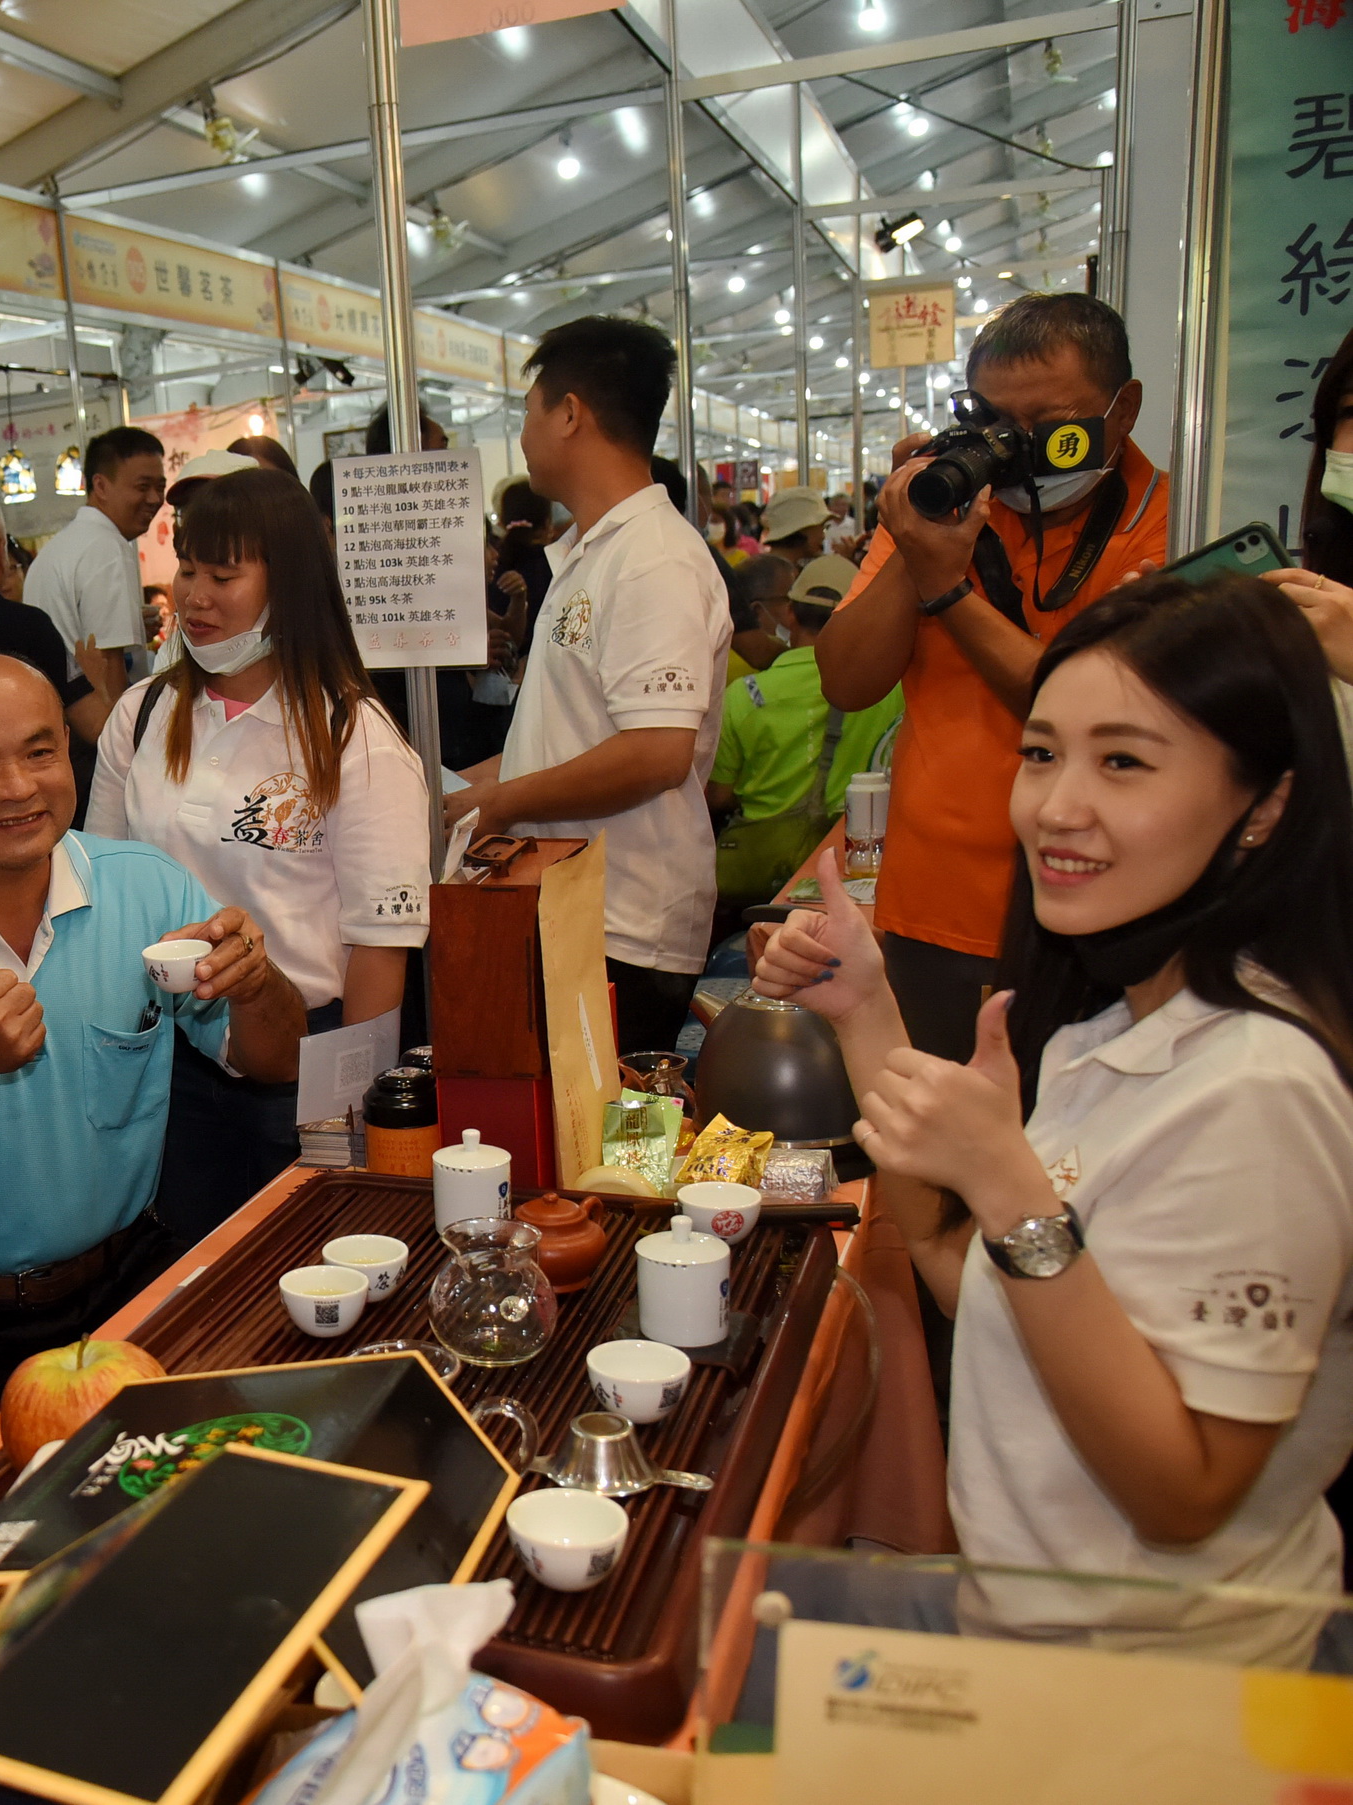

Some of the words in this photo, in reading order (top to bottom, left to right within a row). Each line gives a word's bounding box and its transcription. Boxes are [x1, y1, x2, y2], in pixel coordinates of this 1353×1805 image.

[949, 429, 968, 437] Nikon
[1055, 432, 1081, 460] 勇
[343, 506, 355, 516] 10
[357, 502, 393, 516] 點半泡
[395, 501, 419, 513] 103k
[422, 496, 471, 512] 英雄冬茶
[343, 524, 355, 535] 11
[344, 542, 356, 552] 12
[358, 536, 442, 552] 點泡高海拔秋茶
[344, 561, 351, 571] 2
[353, 558, 377, 571] 點泡
[380, 556, 404, 568] 103k
[405, 553, 454, 568] 英雄冬茶
[1069, 543, 1097, 579] Nikon
[345, 578, 352, 588] 3
[354, 573, 437, 589] 點泡高海拔秋茶
[354, 594, 367, 607] 點
[369, 594, 387, 605] 95k
[390, 592, 414, 606] 冬茶
[355, 610, 379, 625] 點泡
[381, 611, 406, 623] 101k
[408, 608, 457, 624] 英雄冬茶
